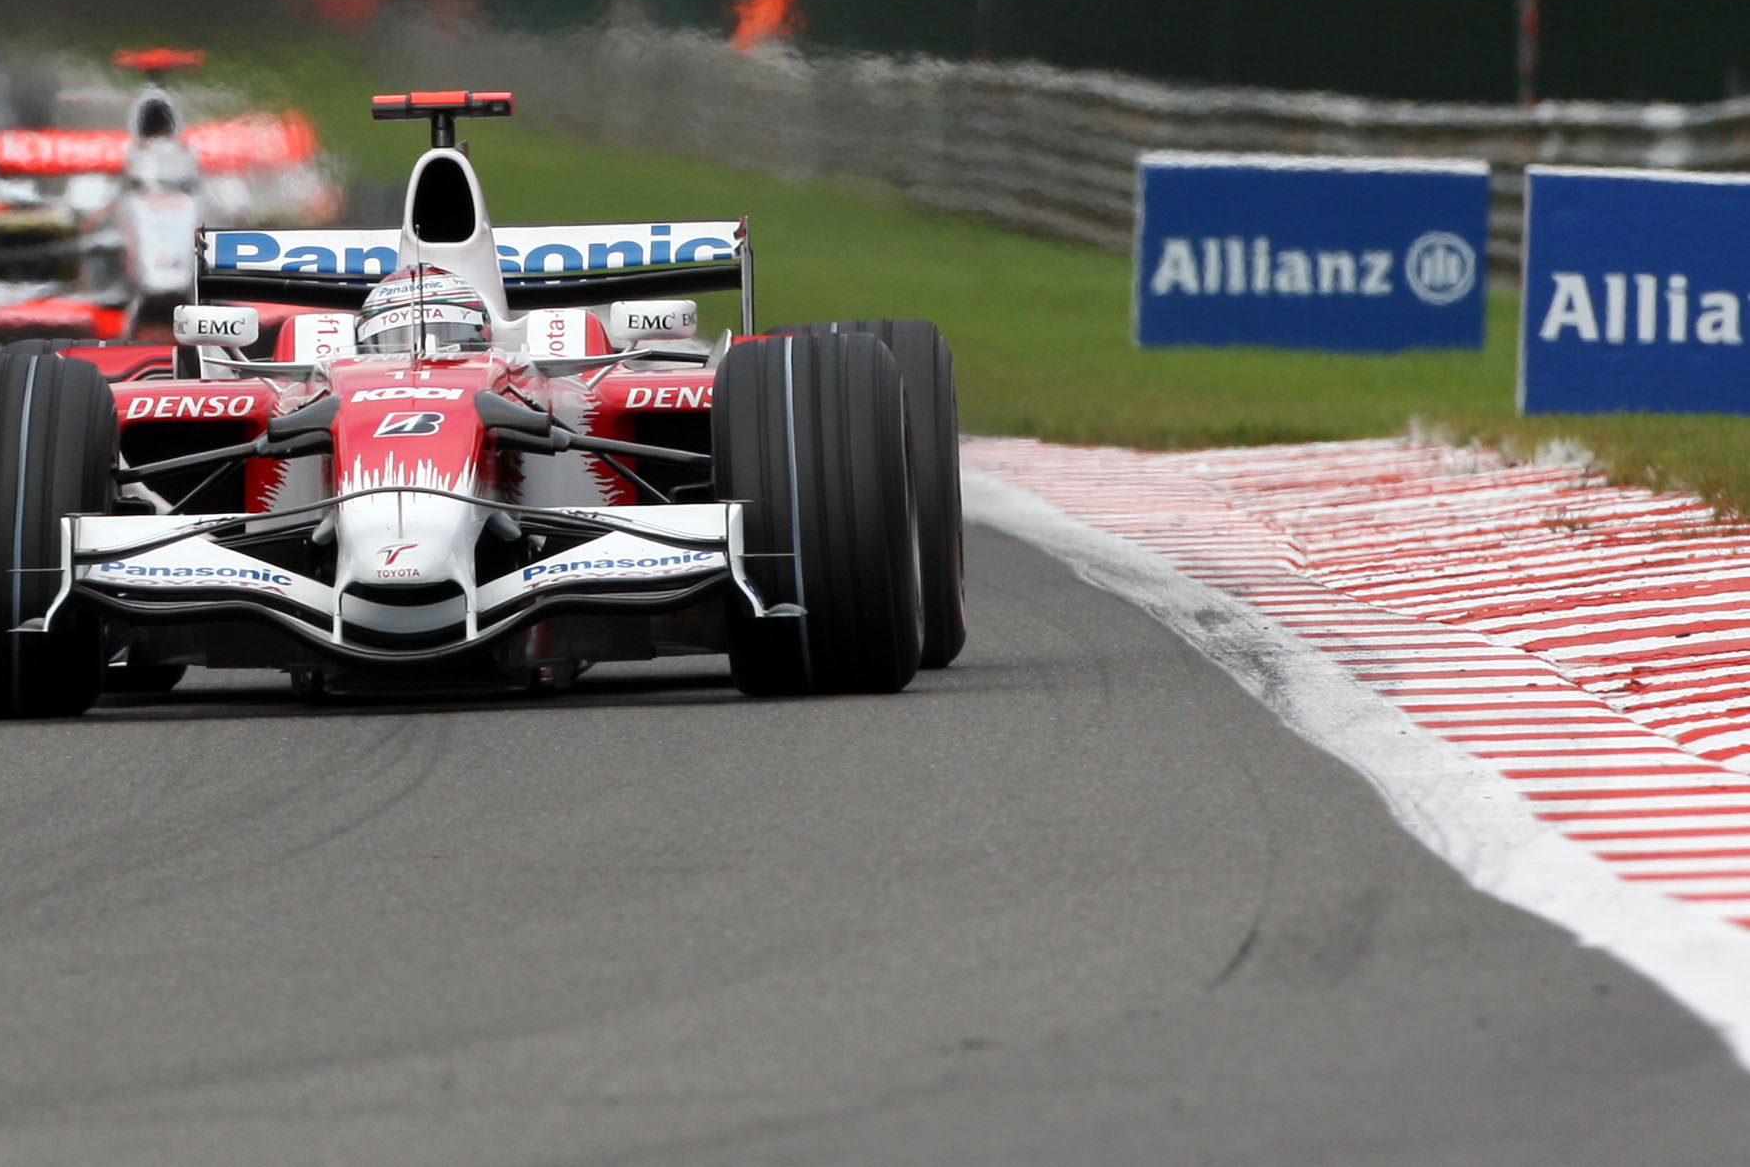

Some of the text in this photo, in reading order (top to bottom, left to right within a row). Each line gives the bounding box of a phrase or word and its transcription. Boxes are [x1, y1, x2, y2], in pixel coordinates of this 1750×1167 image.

[215, 224, 734, 274] Pansonic
[1152, 236, 1396, 297] Allianz
[379, 280, 444, 297] Panasonic
[380, 308, 445, 327] TOYOTA
[1538, 270, 1750, 347] Allia
[351, 386, 464, 403] KDDI
[126, 395, 255, 420] DENSO
[101, 561, 292, 586] Panasonic
[376, 569, 420, 579] TOYOTA
[522, 551, 715, 582] Panasonic
